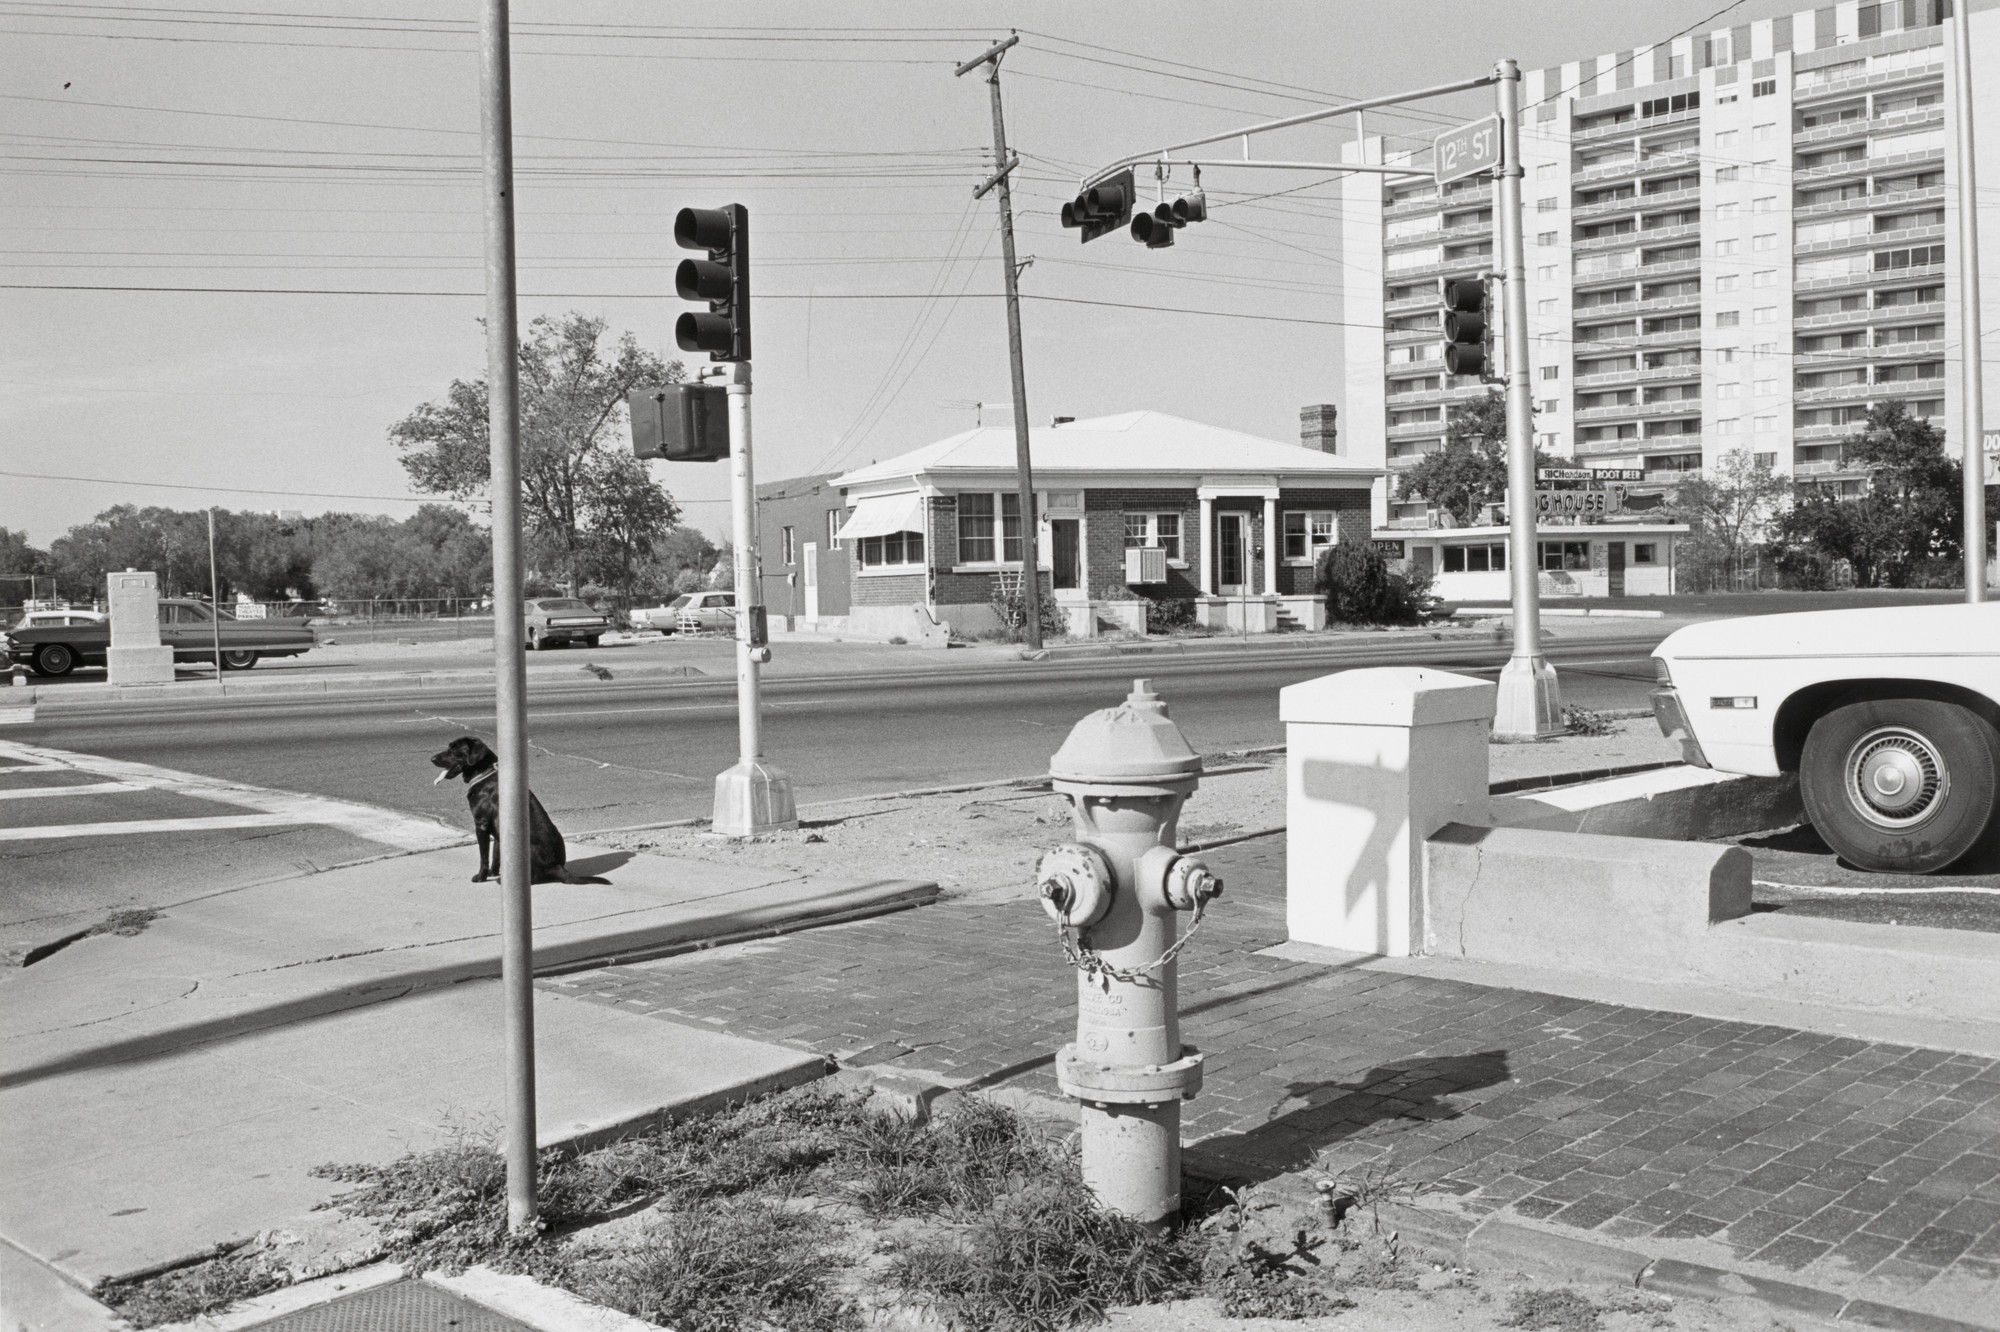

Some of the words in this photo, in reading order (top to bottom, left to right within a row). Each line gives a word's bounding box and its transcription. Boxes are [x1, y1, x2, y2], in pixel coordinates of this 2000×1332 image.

[1440, 137, 1468, 172] 12TH
[1472, 127, 1493, 161] ST
[1596, 470, 1620, 479] ROOT
[1622, 470, 1641, 479] BEER
[1553, 494, 1606, 512] HOUSE
[1371, 541, 1400, 551] OPEN
